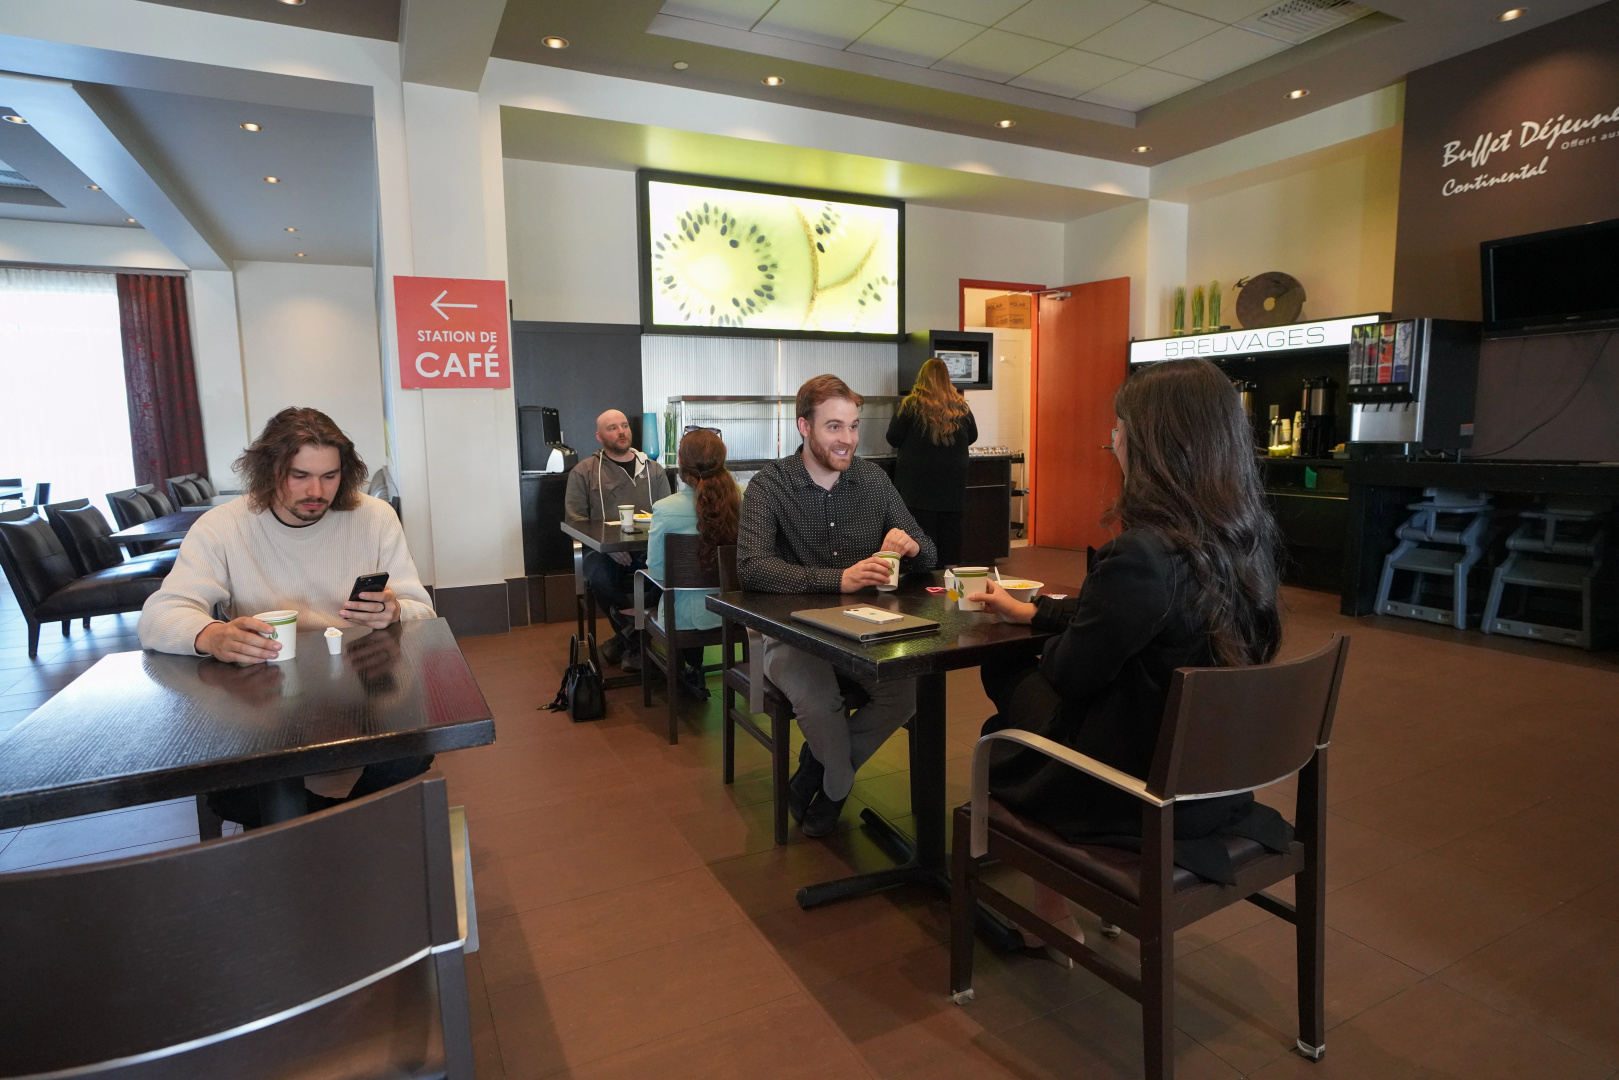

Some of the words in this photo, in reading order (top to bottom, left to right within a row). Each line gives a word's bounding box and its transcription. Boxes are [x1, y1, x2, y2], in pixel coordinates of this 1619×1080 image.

[1442, 130, 1513, 168] Buffet
[1560, 136, 1597, 150] Offert
[1441, 156, 1549, 196] Continental
[417, 330, 476, 343] STATION
[480, 331, 498, 343] DE
[1165, 326, 1325, 357] BREUVAGES
[415, 345, 500, 378] CAFÉ
